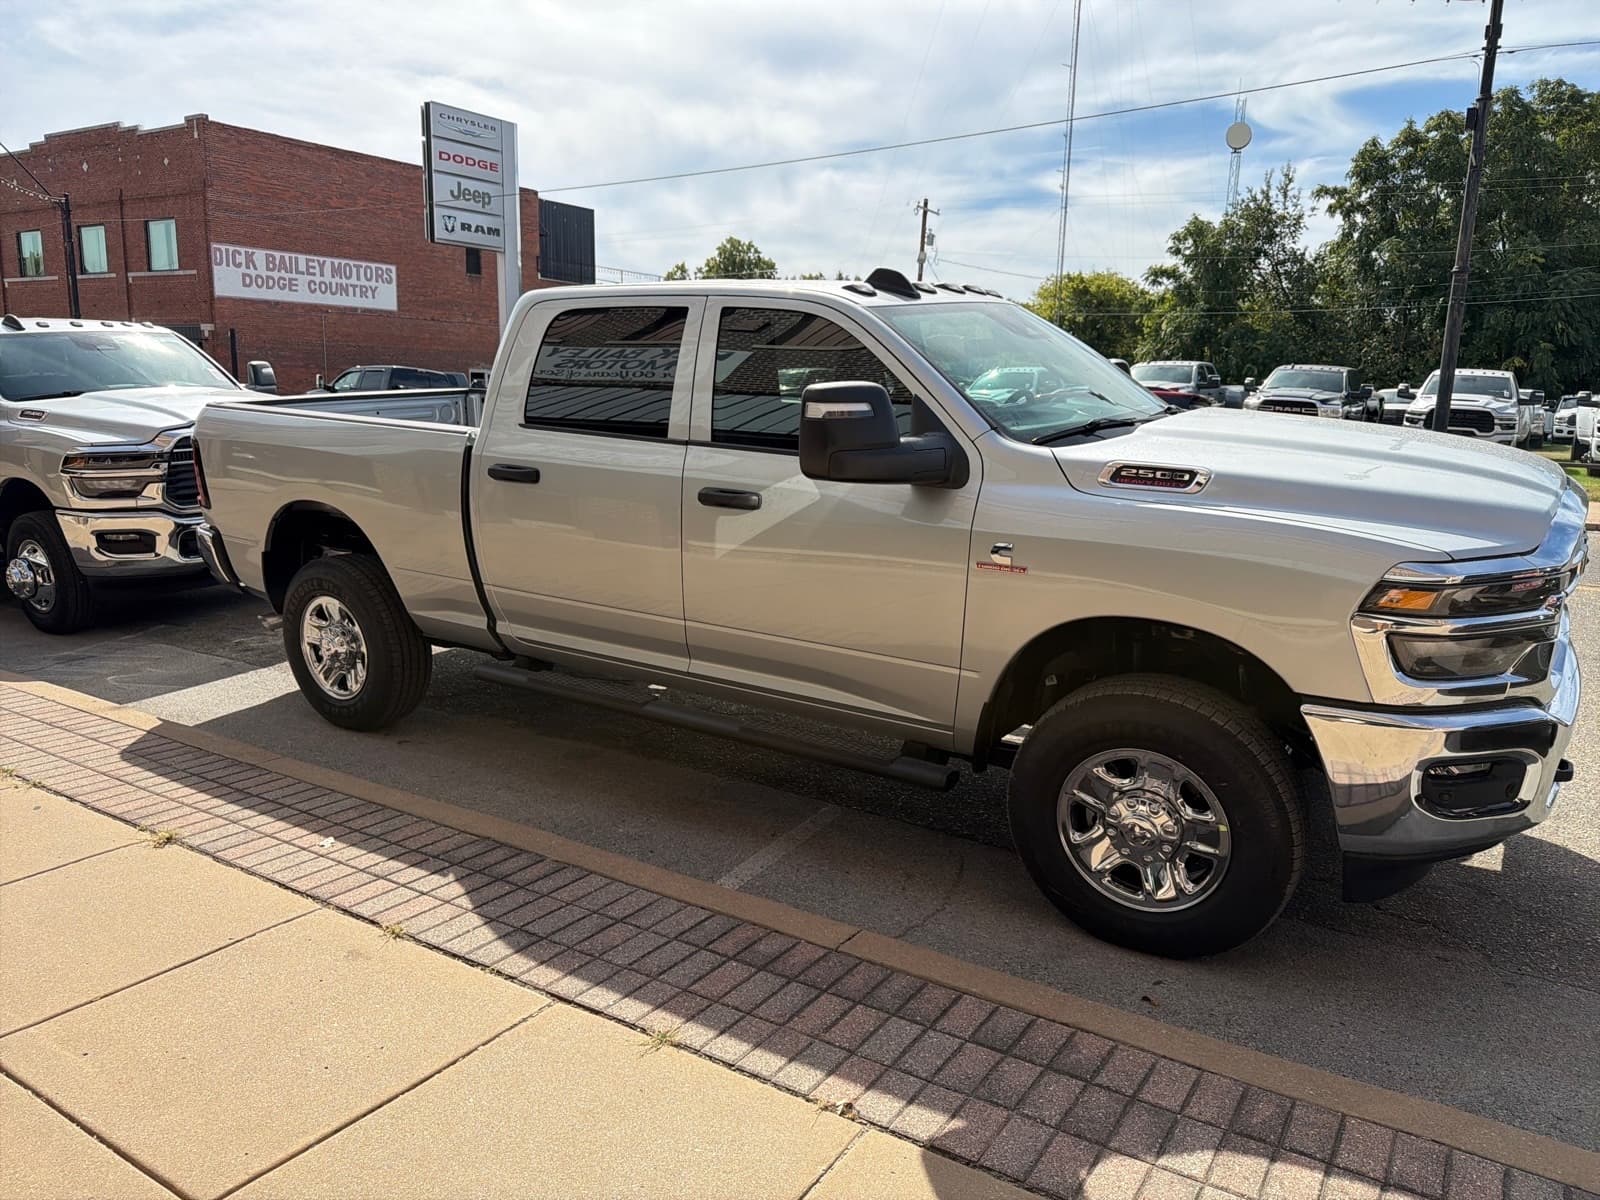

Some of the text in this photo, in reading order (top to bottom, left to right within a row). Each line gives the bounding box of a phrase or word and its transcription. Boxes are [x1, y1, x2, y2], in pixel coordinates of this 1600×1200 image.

[440, 113, 496, 132] CHRYSLER
[438, 150, 499, 172] DODGE
[450, 181, 492, 208] Jeep
[460, 222, 500, 237] RAM
[213, 247, 393, 285] DICK BAILEY MOTORS
[241, 273, 379, 299] DODGE COUNTRY
[1120, 469, 1189, 480] 2500
